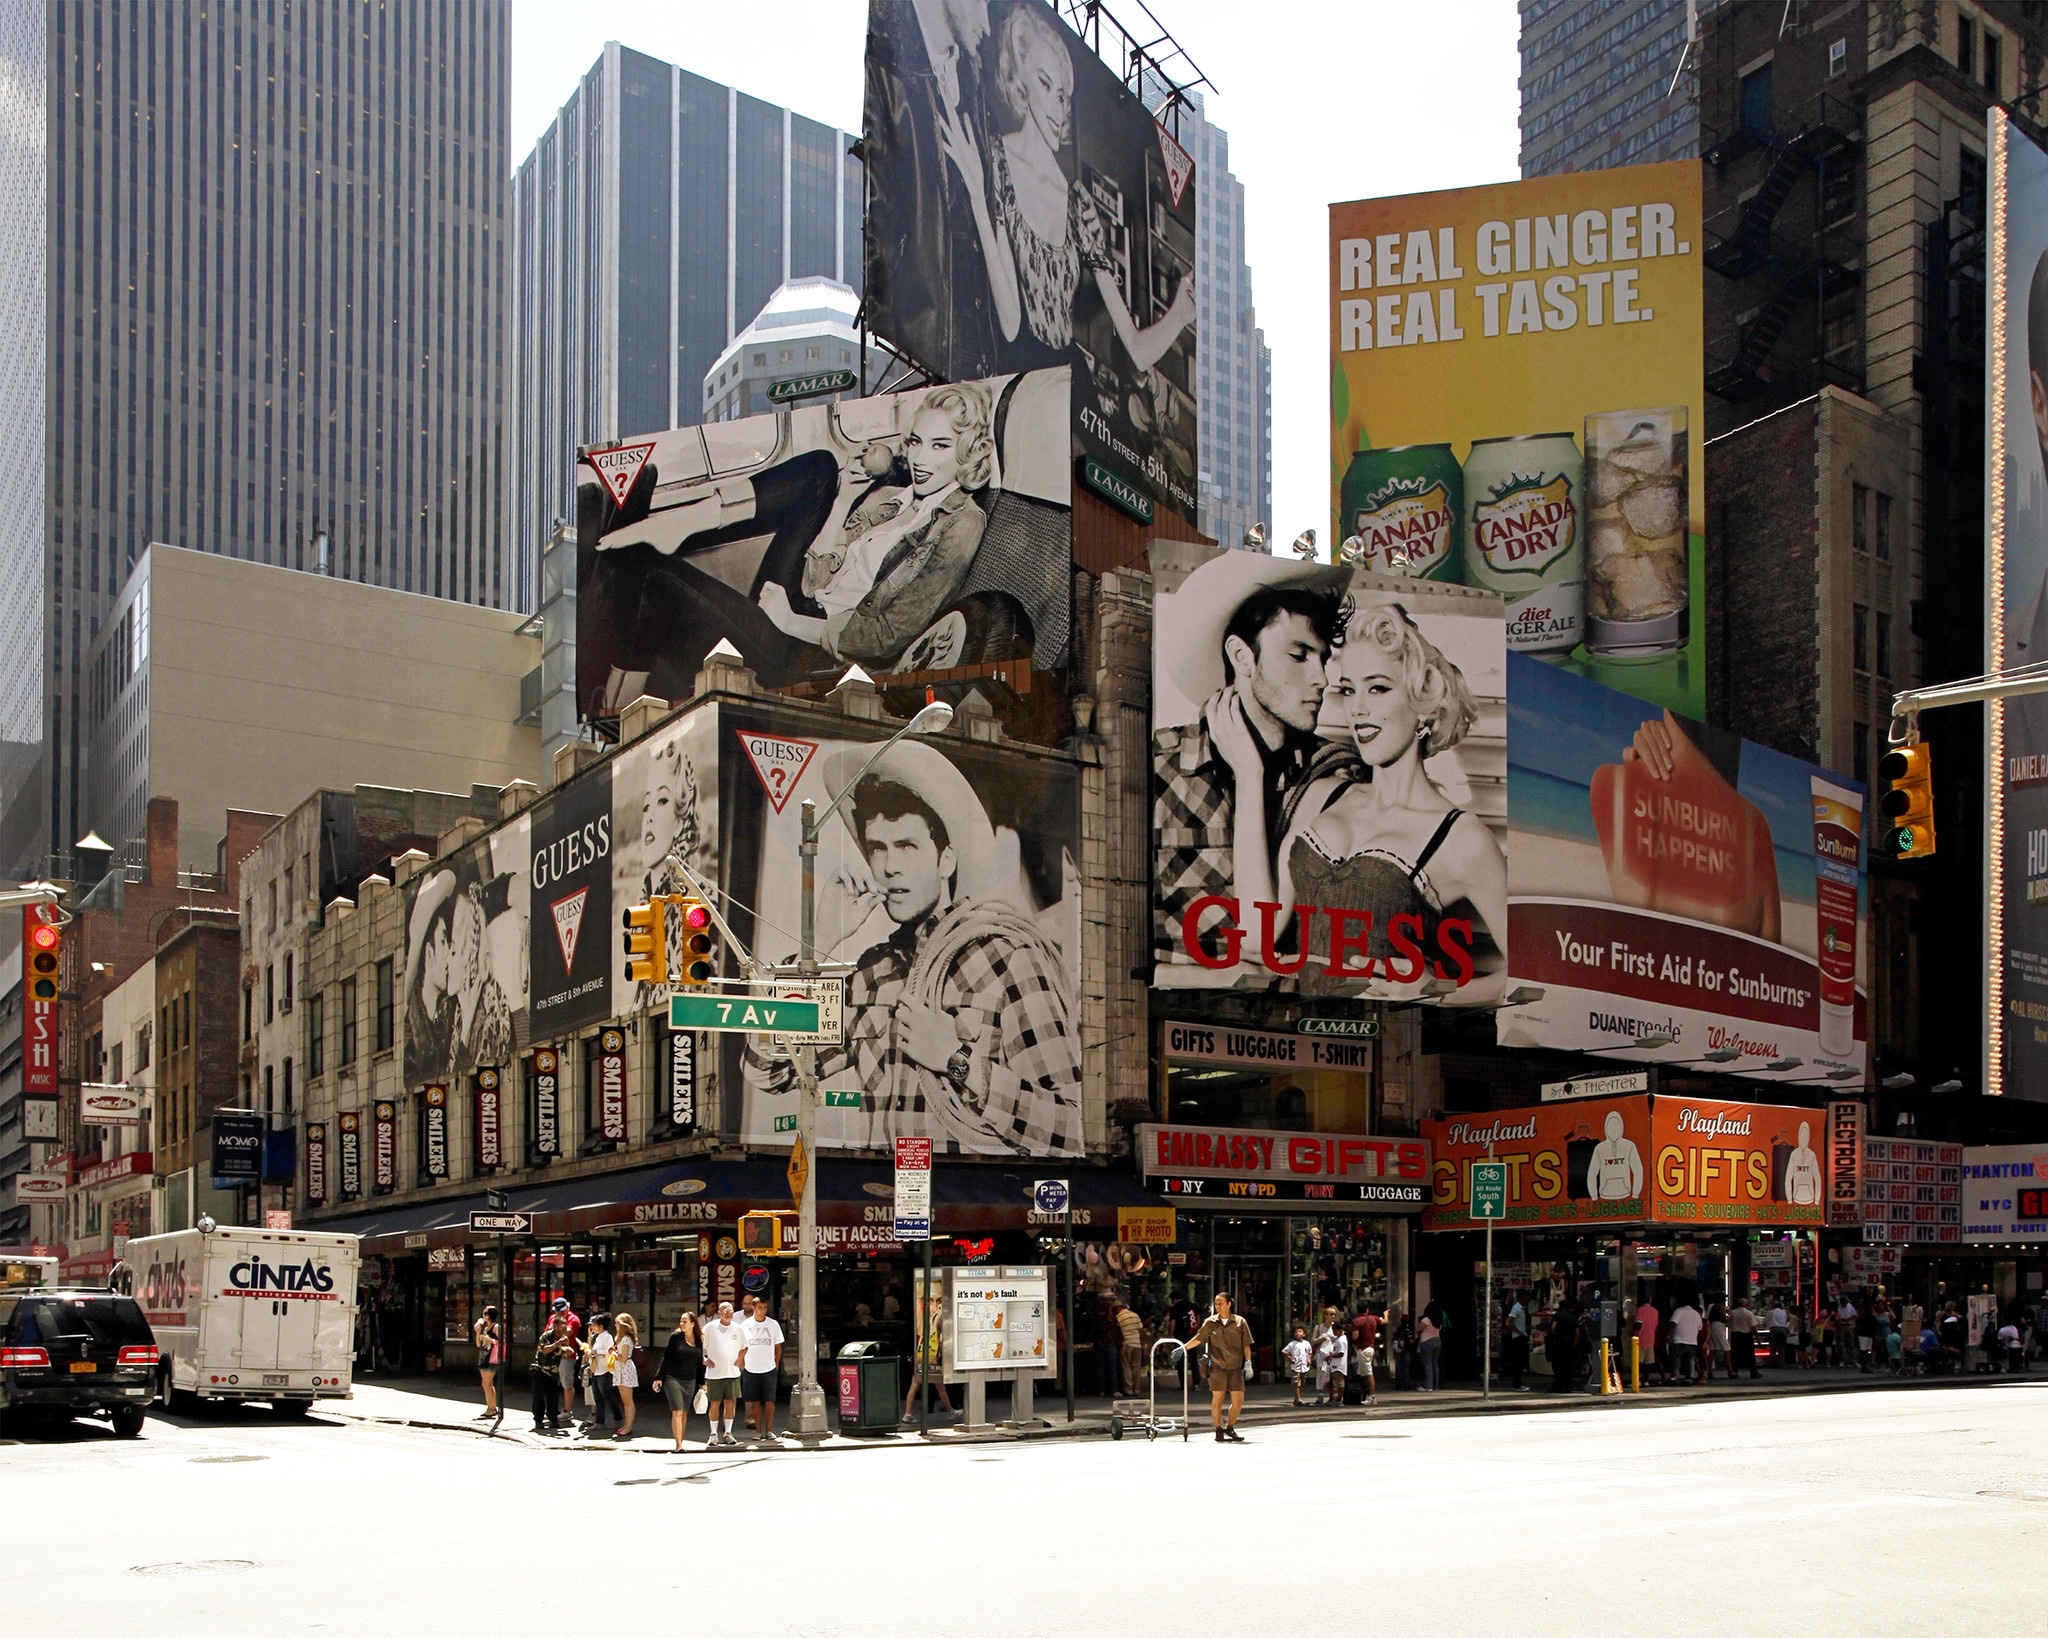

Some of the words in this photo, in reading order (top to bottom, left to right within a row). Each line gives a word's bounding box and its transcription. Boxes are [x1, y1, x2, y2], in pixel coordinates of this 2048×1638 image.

[1161, 134, 1188, 174] GUESS
[1340, 227, 1463, 292] REAL
[1476, 202, 1690, 277] GINGER.
[1340, 288, 1464, 352] REAL
[1475, 268, 1654, 338] TASTE.
[775, 372, 845, 397] LAMAR
[599, 451, 644, 470] GUESS
[1080, 406, 1111, 446] 47th
[1112, 438, 1140, 467] STREET
[1141, 459, 1146, 472] &
[1147, 455, 1168, 489] 5th
[1168, 481, 1195, 510] AVENUE
[1093, 467, 1149, 514] LAMAR
[1381, 508, 1402, 521] SINCE
[1501, 501, 1523, 513] SINCE
[1357, 503, 1454, 559] CANADA
[1474, 496, 1577, 552] CANADA
[1384, 532, 1437, 569] DRY
[1504, 524, 1559, 562] DRY
[1518, 607, 1552, 622] diet
[1548, 616, 1575, 632] ALE
[750, 740, 804, 763] GUESS
[2010, 754, 2039, 782] DANIEL
[1634, 792, 1738, 846] SUNBURN
[533, 813, 610, 890] GUESS
[1636, 824, 1736, 881] HAPPENS
[556, 897, 582, 923] GUESS
[1181, 895, 1475, 988] GUESS
[1556, 930, 1604, 967] Your
[1611, 942, 1655, 978] First
[1660, 954, 1692, 986] Aid
[1697, 960, 1723, 993] for
[536, 996, 548, 1011] 47th
[547, 991, 567, 1008] STREET
[581, 976, 604, 994] AVENUE
[821, 982, 840, 992] AREA
[830, 995, 839, 1004] FT
[717, 1003, 733, 1024] 7
[741, 1005, 778, 1026] Av
[1304, 1020, 1372, 1034] LAMAR
[1171, 1028, 1214, 1054] GIFTS
[1227, 1033, 1296, 1061] LUGGAGE
[1311, 1041, 1367, 1067] T-SHIRT
[30, 1074, 50, 1085] MUSIC
[1584, 1077, 1637, 1093] THEATER
[831, 1092, 840, 1105] 7
[1447, 1115, 1536, 1150] Playland
[1677, 1108, 1751, 1141] Playland
[218, 1136, 259, 1146] MOMO
[1157, 1131, 1275, 1170] EMBASSY
[1288, 1137, 1426, 1178] GIFTS
[1835, 1104, 1856, 1199] ELECTRONICS
[1866, 1143, 1885, 1158] NYC
[1891, 1144, 1911, 1160] GIFT
[1917, 1146, 1934, 1161] NYC
[1940, 1147, 1958, 1163] GIFT
[1432, 1149, 1563, 1207] GITS
[1657, 1145, 1768, 1199] GIFTS
[1865, 1163, 1885, 1179] GIFT
[1892, 1165, 1910, 1180] NYC
[1915, 1167, 1935, 1181] GIFT
[1941, 1168, 1958, 1182] NYC
[1963, 1162, 2034, 1179] PHANTOM
[1040, 1186, 1048, 1196] P
[1359, 1186, 1421, 1200] LUGGAGE
[1478, 1192, 1500, 1200] South
[1866, 1184, 1885, 1199] NYC
[1890, 1185, 1910, 1200] GIFT
[1917, 1186, 1934, 1201] NYC
[1940, 1187, 1958, 1202] GIFT
[634, 1202, 718, 1222] SMILER'S
[1549, 1203, 1577, 1219] HATS
[1586, 1199, 1643, 1218] LUGGAGE
[1657, 1202, 1696, 1218] T-SHIRTS
[1702, 1203, 1750, 1220] SOUVENIRS
[1757, 1204, 1777, 1220] HATS
[1784, 1205, 1821, 1220] LUGGAGE
[1865, 1204, 1885, 1219] GIFT
[1892, 1205, 1910, 1220] NYC
[1915, 1206, 1935, 1221] GIFT
[1941, 1207, 1958, 1221] NYC
[1980, 1198, 2012, 1210] NYC
[479, 1218, 497, 1226] ONE
[504, 1218, 523, 1227] WAY
[1832, 1212, 1858, 1220] PHOTO
[1119, 1225, 1129, 1242] 1
[1131, 1226, 1143, 1237] HR
[1145, 1226, 1172, 1237] PHOTO
[1866, 1225, 1885, 1239] NYC
[1890, 1225, 1910, 1240] GIFT
[1916, 1226, 1934, 1240] NYC
[1940, 1227, 1958, 1241] GIFT
[1963, 1224, 2003, 1234] LUGGAGE
[2011, 1223, 2047, 1233] SPORTS
[957, 1290, 969, 1298] it's
[1000, 1290, 1018, 1298] fault
